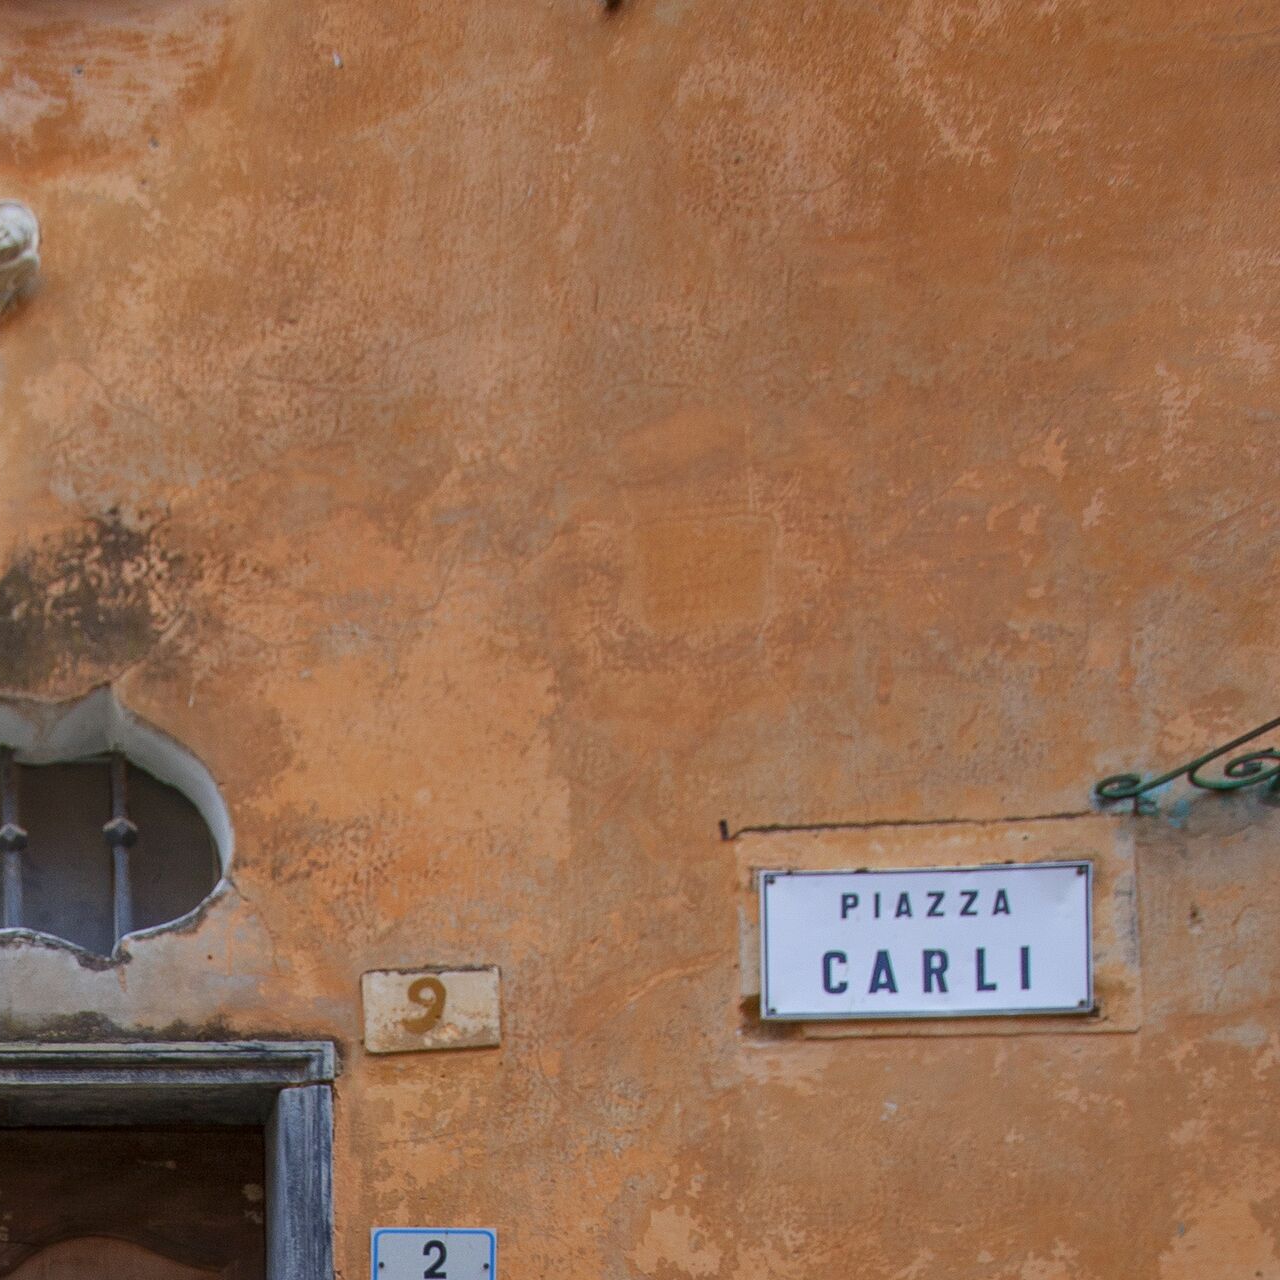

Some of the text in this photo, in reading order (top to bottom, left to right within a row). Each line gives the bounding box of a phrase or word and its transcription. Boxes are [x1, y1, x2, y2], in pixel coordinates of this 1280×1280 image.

[840, 888, 1012, 919] PIAZZA
[822, 945, 1031, 994] CARLI
[401, 976, 447, 1036] 9
[422, 1239, 448, 1280] 2
